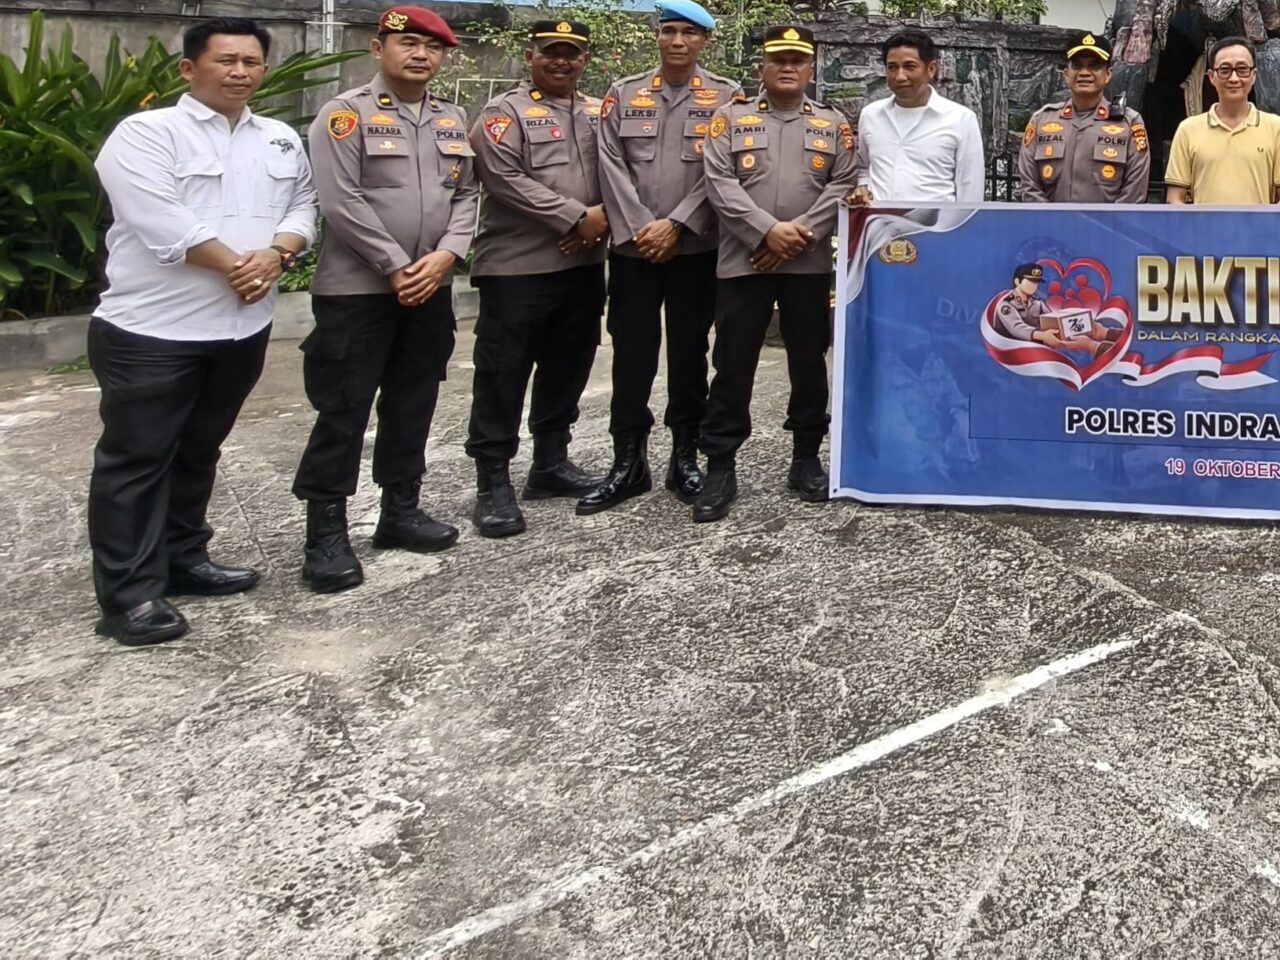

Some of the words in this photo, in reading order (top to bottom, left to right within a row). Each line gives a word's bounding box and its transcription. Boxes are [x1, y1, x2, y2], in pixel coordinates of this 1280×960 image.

[624, 109, 657, 118] LEKSI
[525, 118, 557, 127] RIZAL
[367, 126, 402, 136] NAZARA
[436, 130, 466, 140] POLRI
[733, 126, 766, 135] AMRI
[805, 128, 835, 139] POLRI
[1097, 136, 1127, 146] POLRI
[1138, 330, 1200, 342] DALAM
[1065, 408, 1176, 437] POLRES
[1165, 457, 1186, 475] 19
